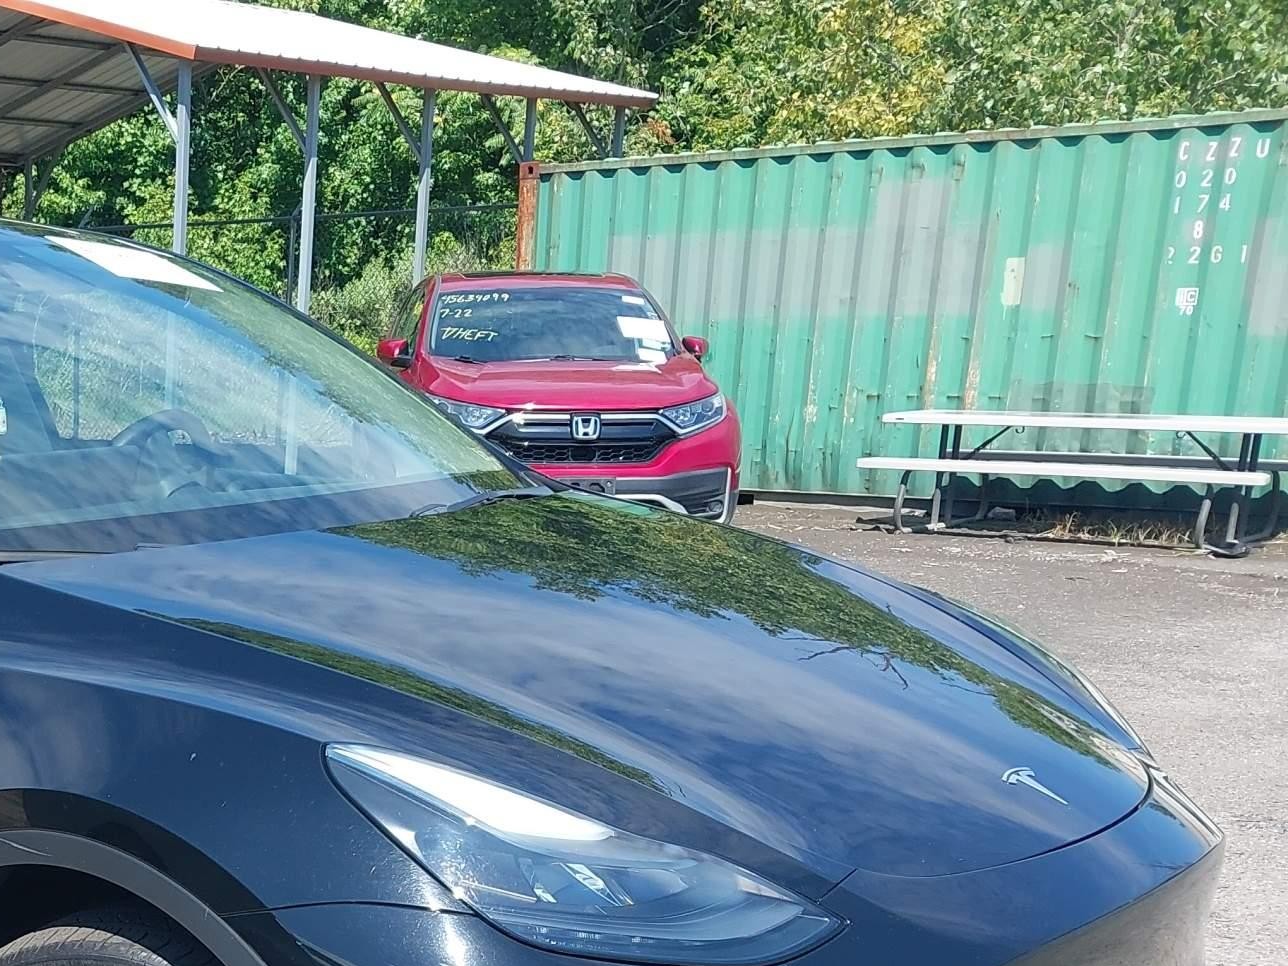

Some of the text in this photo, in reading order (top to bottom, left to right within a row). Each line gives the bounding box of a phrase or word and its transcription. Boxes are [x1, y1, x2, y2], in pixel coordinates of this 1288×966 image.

[1178, 137, 1271, 161] CZZU
[1175, 168, 1237, 188] 020
[1173, 194, 1231, 214] 174
[1192, 220, 1205, 239] 8
